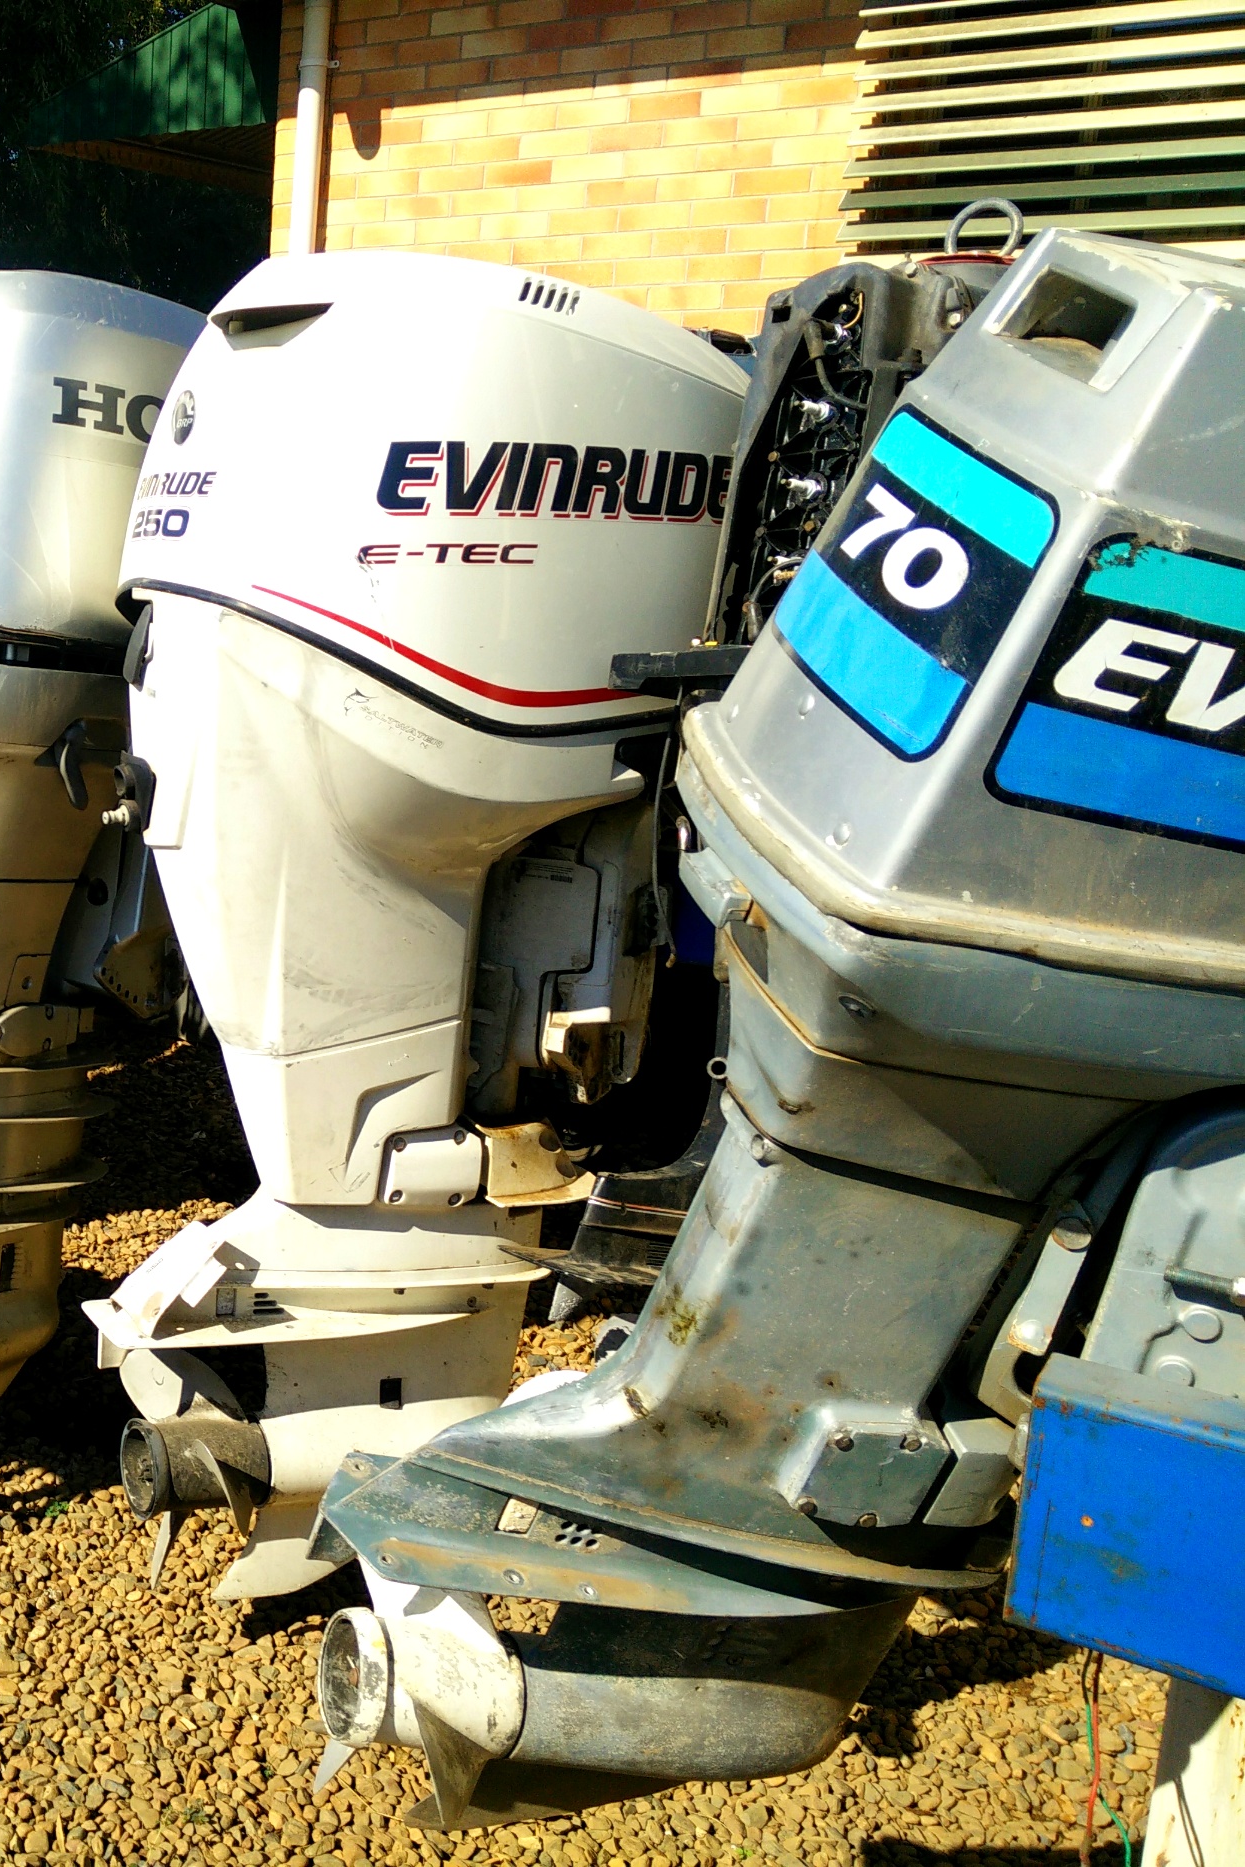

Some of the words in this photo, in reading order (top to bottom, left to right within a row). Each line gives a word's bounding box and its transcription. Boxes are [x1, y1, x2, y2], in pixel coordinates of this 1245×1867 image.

[131, 508, 191, 539] 250
[375, 440, 734, 524] EVINRUDE
[356, 543, 539, 565] E-TEC
[840, 483, 970, 610] 70
[1053, 618, 1245, 732] EV
